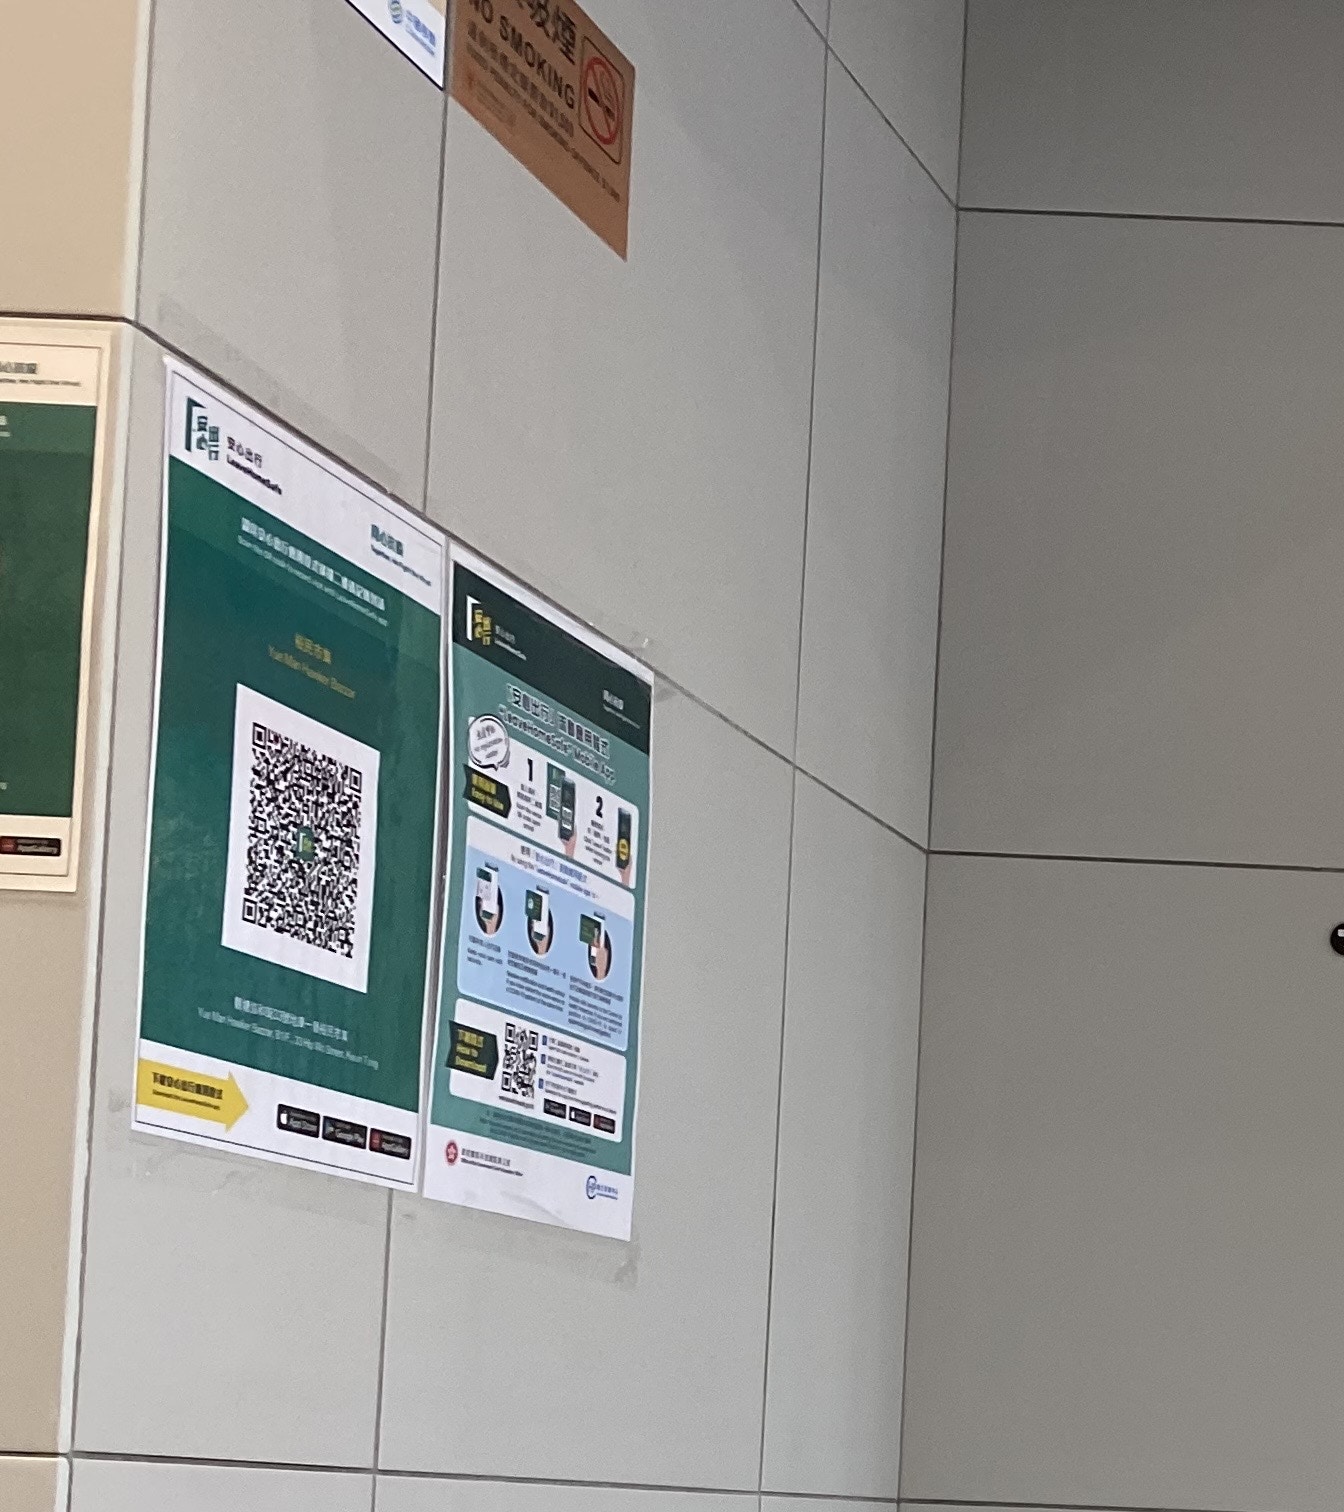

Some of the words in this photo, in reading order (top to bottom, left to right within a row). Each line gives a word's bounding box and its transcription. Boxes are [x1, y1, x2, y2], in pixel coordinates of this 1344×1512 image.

[516, 0, 576, 66] 吸煙
[499, 15, 575, 109] SMOKING
[527, 757, 533, 782] 1
[595, 796, 603, 819] 2
